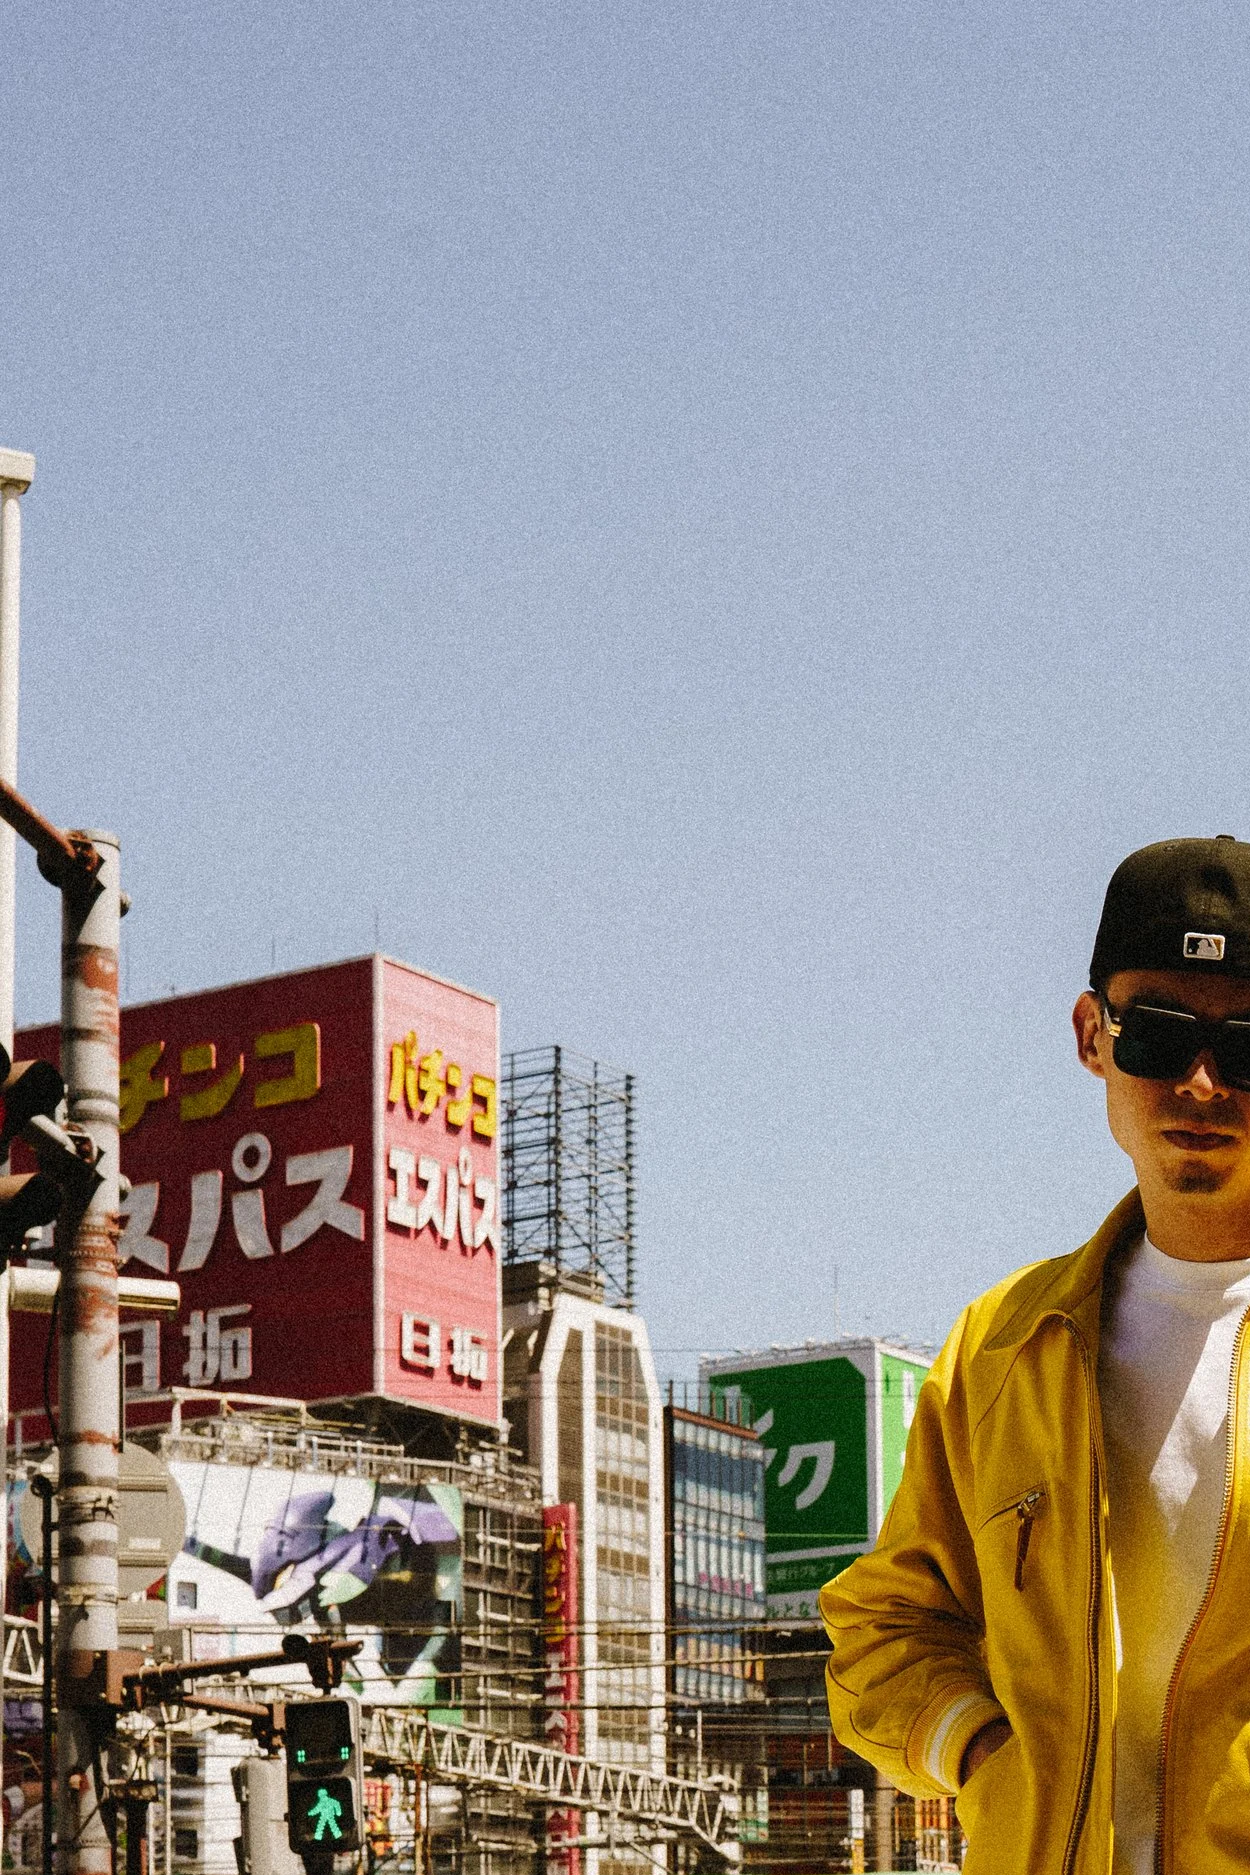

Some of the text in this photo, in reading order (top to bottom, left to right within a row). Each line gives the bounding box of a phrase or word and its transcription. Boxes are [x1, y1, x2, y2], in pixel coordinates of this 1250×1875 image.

[387, 1029, 497, 1140] パチンコ
[386, 1145, 499, 1250] エスパス
[401, 1310, 489, 1383] 日拓
